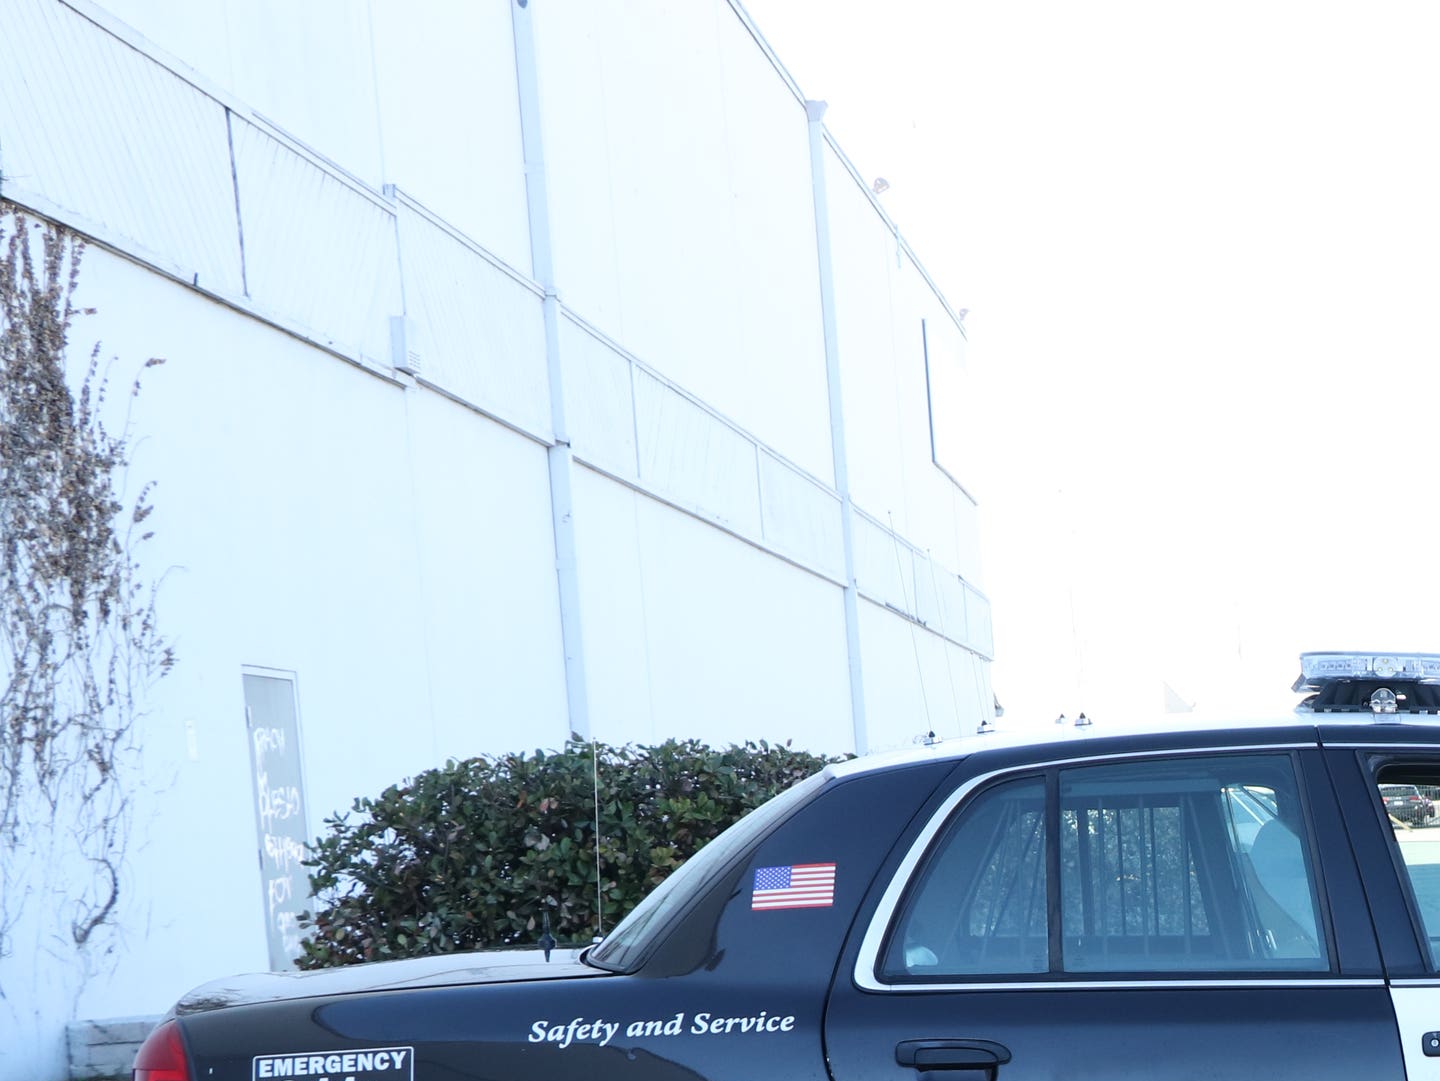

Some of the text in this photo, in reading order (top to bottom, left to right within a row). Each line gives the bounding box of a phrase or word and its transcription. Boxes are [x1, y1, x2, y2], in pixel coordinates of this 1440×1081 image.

[528, 1011, 795, 1049] Safety and Service
[258, 1051, 407, 1078] EMERGENCY
